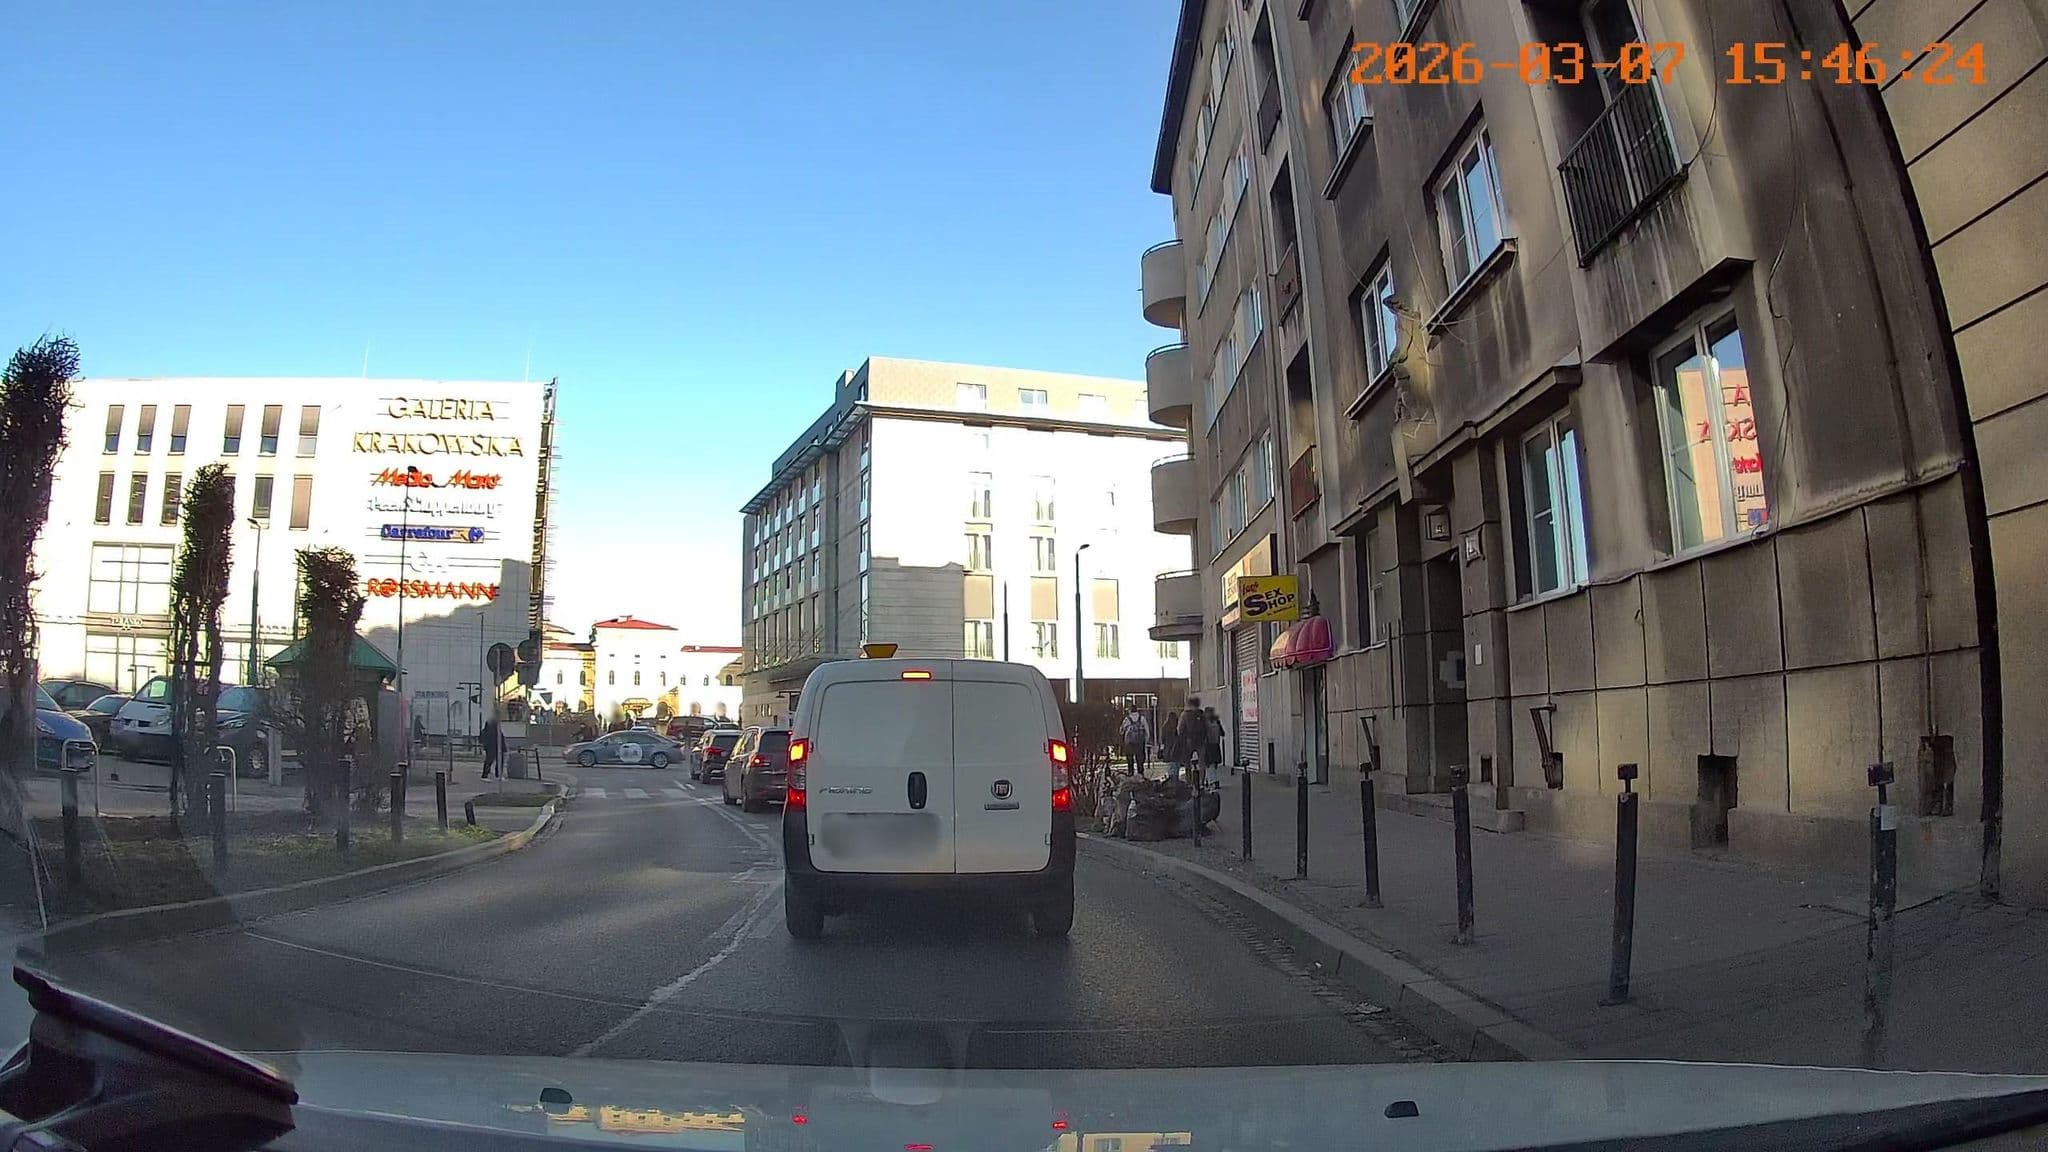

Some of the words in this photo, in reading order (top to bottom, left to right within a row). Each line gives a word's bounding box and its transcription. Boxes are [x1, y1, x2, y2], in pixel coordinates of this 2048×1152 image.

[388, 398, 495, 420] GALERIA
[353, 432, 524, 457] KRAKOWSKA
[381, 524, 454, 539] Carrefour
[366, 578, 498, 600] ROSSMANN
